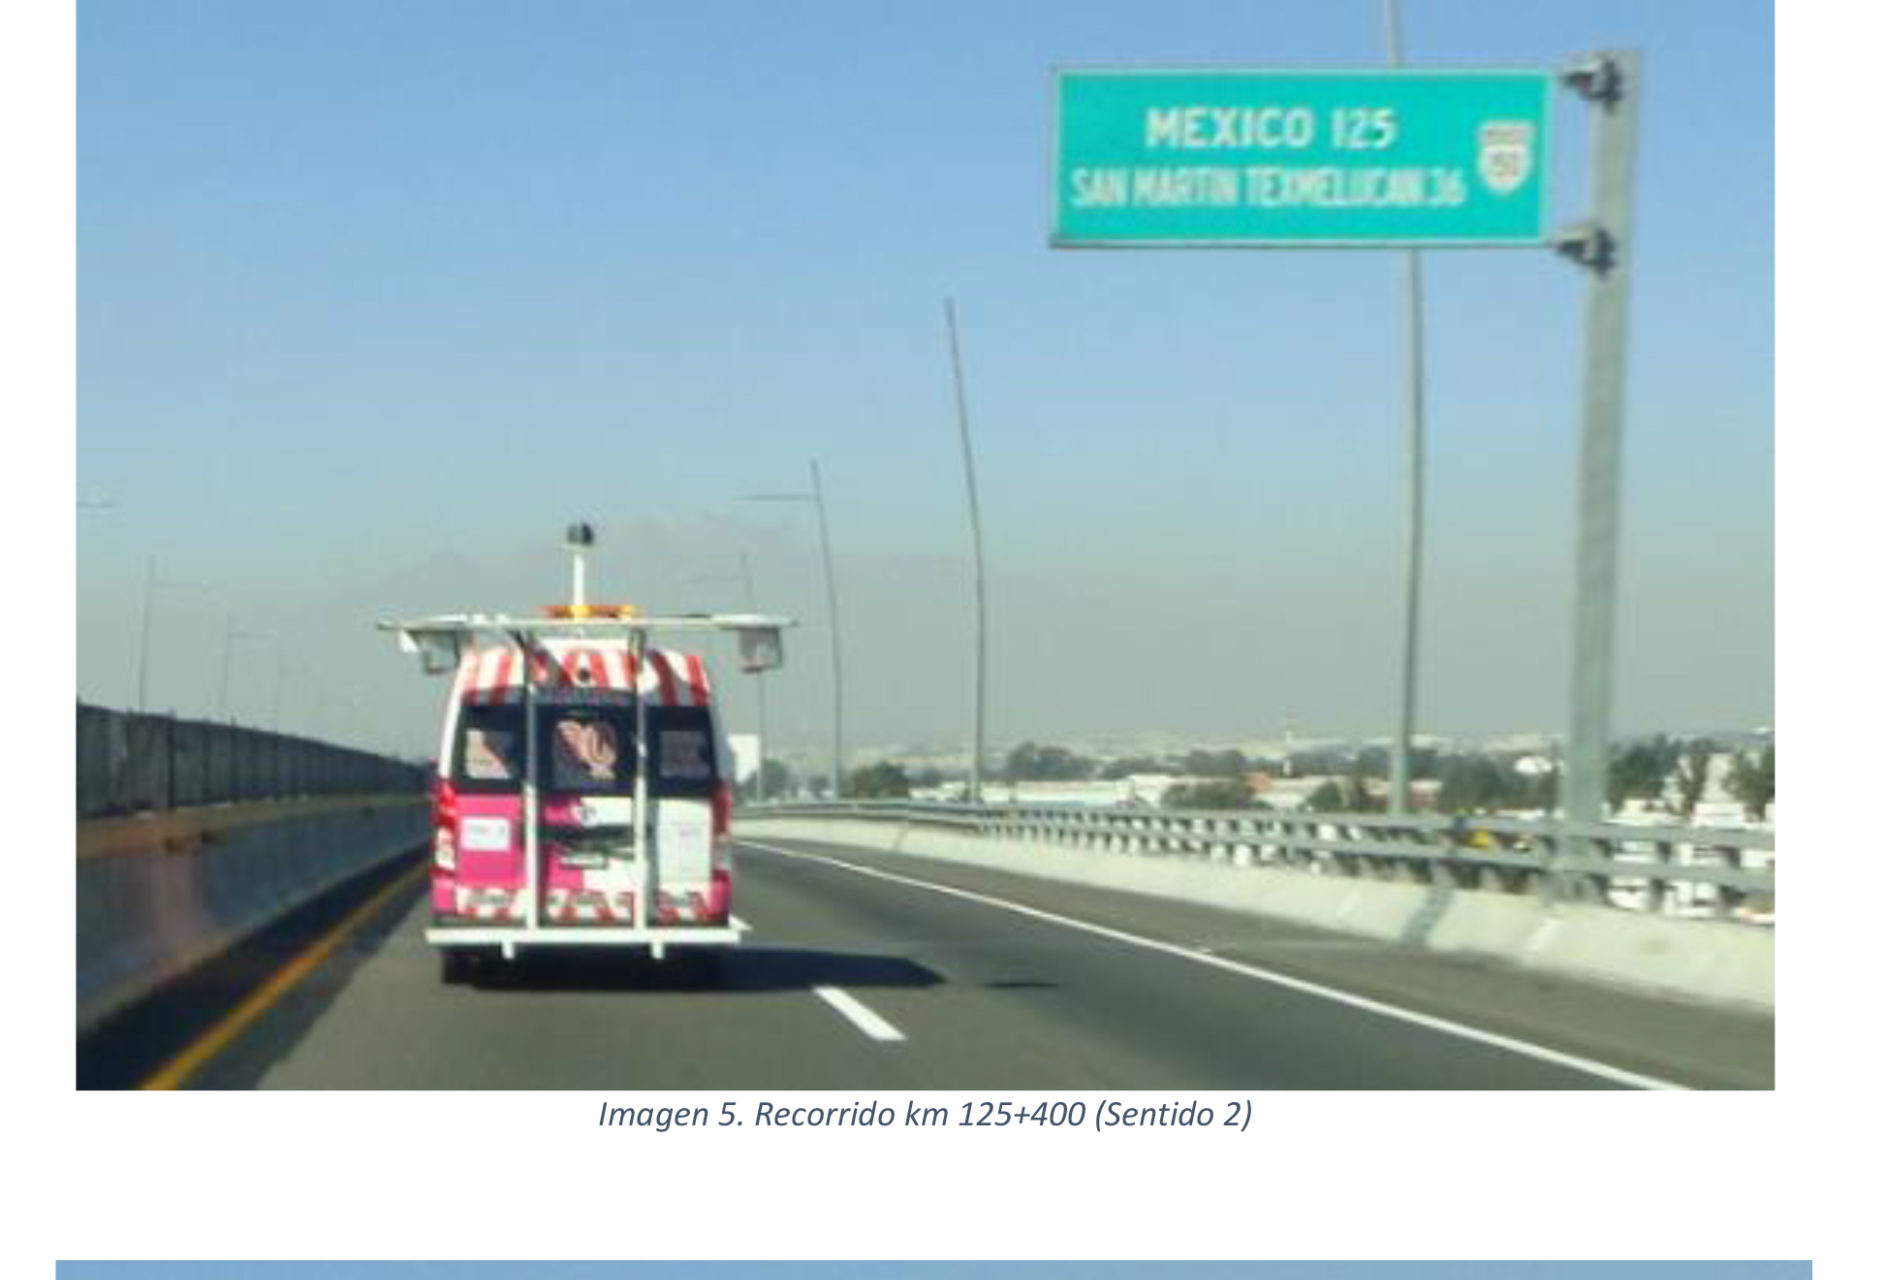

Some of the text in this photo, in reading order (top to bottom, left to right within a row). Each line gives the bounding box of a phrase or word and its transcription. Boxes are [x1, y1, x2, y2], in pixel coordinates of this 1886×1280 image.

[1145, 107, 1396, 150] MEXICO 125
[1071, 167, 1128, 209] SAN
